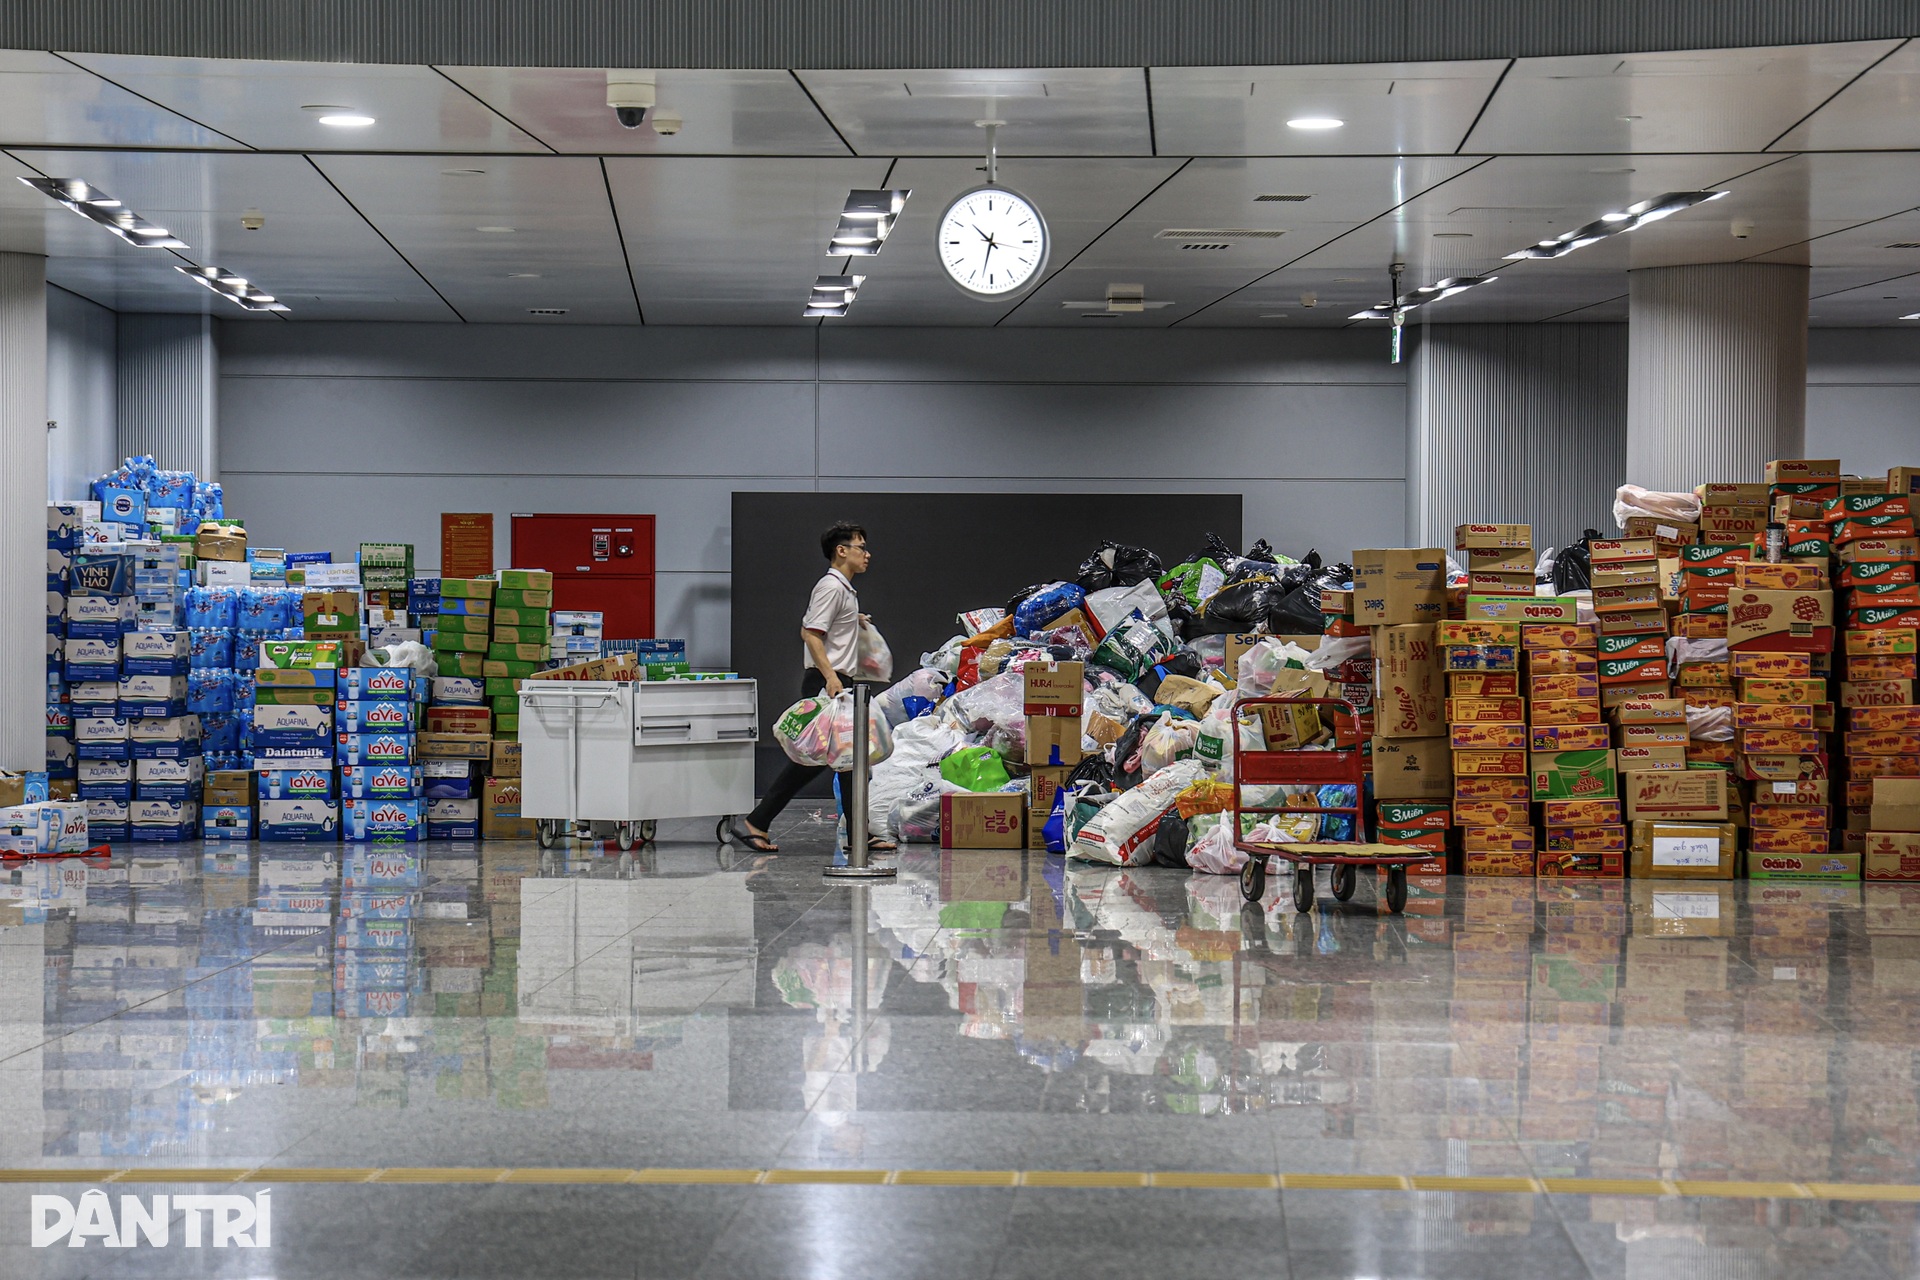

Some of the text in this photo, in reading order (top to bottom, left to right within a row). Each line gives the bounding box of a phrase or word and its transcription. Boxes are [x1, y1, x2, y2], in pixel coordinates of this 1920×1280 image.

[1797, 485, 1804, 493] 3
[1853, 497, 1883, 510] 3 Miền
[1712, 519, 1755, 530] VIFON
[1871, 517, 1878, 525] 3
[85, 530, 108, 543] Vie
[1691, 547, 1723, 560] 3 Miền
[1860, 564, 1889, 577] 3 Miền
[1670, 572, 1679, 596] Select
[1876, 585, 1882, 594] 3
[79, 605, 108, 614] AQUAFINA
[1364, 599, 1384, 611] Select
[1732, 604, 1773, 625] Karo
[1866, 609, 1898, 622] 3 Miền
[1235, 634, 1267, 645] Sele
[1606, 637, 1637, 651] 3 Miền
[135, 642, 164, 650] AQUAFINA
[76, 648, 106, 656] AQUAFINA
[1608, 661, 1639, 675] 3 Miền
[1756, 659, 1789, 671] Hảo Hảo
[369, 676, 404, 689] laVie
[1030, 679, 1052, 688] HURA
[444, 686, 472, 695] AQUAFINA
[1857, 693, 1905, 705] VIFON
[1401, 692, 1418, 731] Solite
[1625, 702, 1652, 710] Gấu Đỏ
[46, 714, 69, 725] Vie
[367, 709, 403, 721] laVie
[1743, 711, 1772, 723] Hảo Hảo
[276, 718, 309, 726] AQUAFINA
[87, 726, 116, 734] AQUAFINA
[1558, 727, 1588, 740] Hảo Hảo
[1628, 727, 1656, 735] Gấu Đỏ
[1458, 732, 1486, 742] Hảo Hảo
[1751, 736, 1779, 748] Hảo Hảo
[265, 748, 324, 757] Dalatmilk
[368, 742, 404, 754] laVie
[90, 768, 118, 776] AQUAFINA
[290, 776, 326, 788] laVie
[372, 774, 407, 786] laVie
[1578, 777, 1595, 785] CUP
[1462, 784, 1490, 794] Hảo Hảo
[1571, 781, 1604, 792] NOODLES
[1638, 784, 1661, 799] AFC
[1773, 793, 1820, 804] VIFON
[282, 813, 315, 821] AQUAFINA
[371, 811, 407, 822] laVie
[994, 810, 1006, 825] JIN
[1392, 809, 1401, 822] 3
[1553, 810, 1581, 820] Hảo Hảo
[65, 822, 86, 835] laVie
[1401, 830, 1407, 839] 3
[1487, 833, 1500, 841] Hảo
[1574, 829, 1604, 840] Hảo Hảo
[1760, 837, 1789, 848] Hảo Hảo
[1762, 859, 1801, 869] Gấu Đỏ
